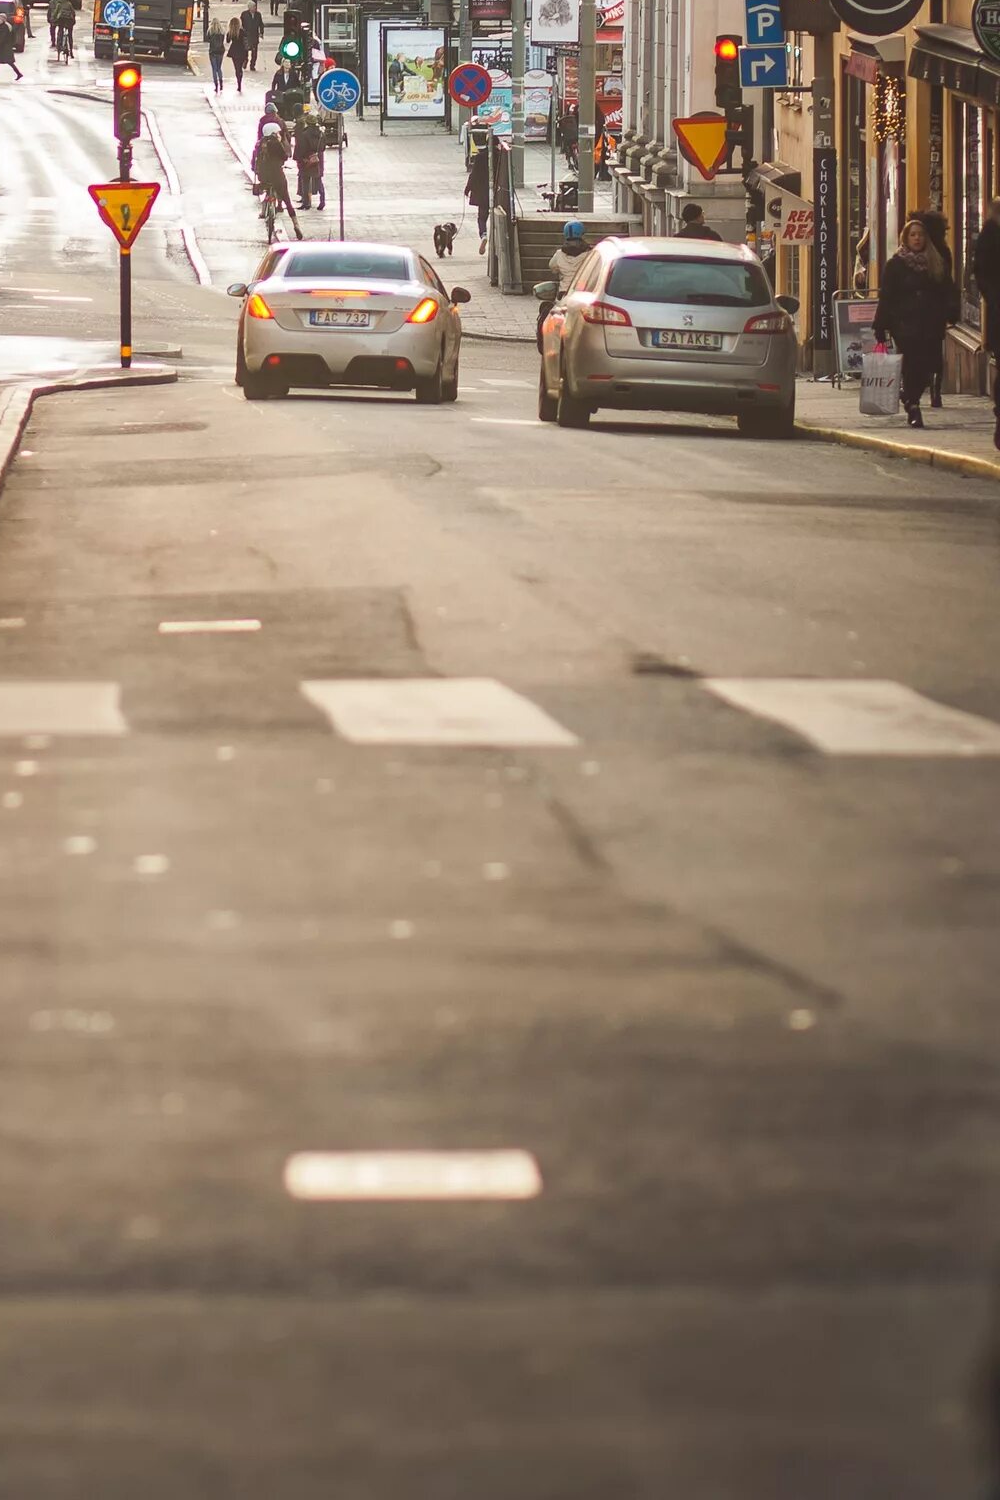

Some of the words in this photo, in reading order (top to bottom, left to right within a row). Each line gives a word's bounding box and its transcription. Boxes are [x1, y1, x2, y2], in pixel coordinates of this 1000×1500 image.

[758, 12, 775, 37] P
[819, 158, 828, 340] CHOKLADFABRIKEN
[316, 311, 338, 323] FAC
[345, 312, 367, 324] 732
[661, 331, 712, 345] SATAKE
